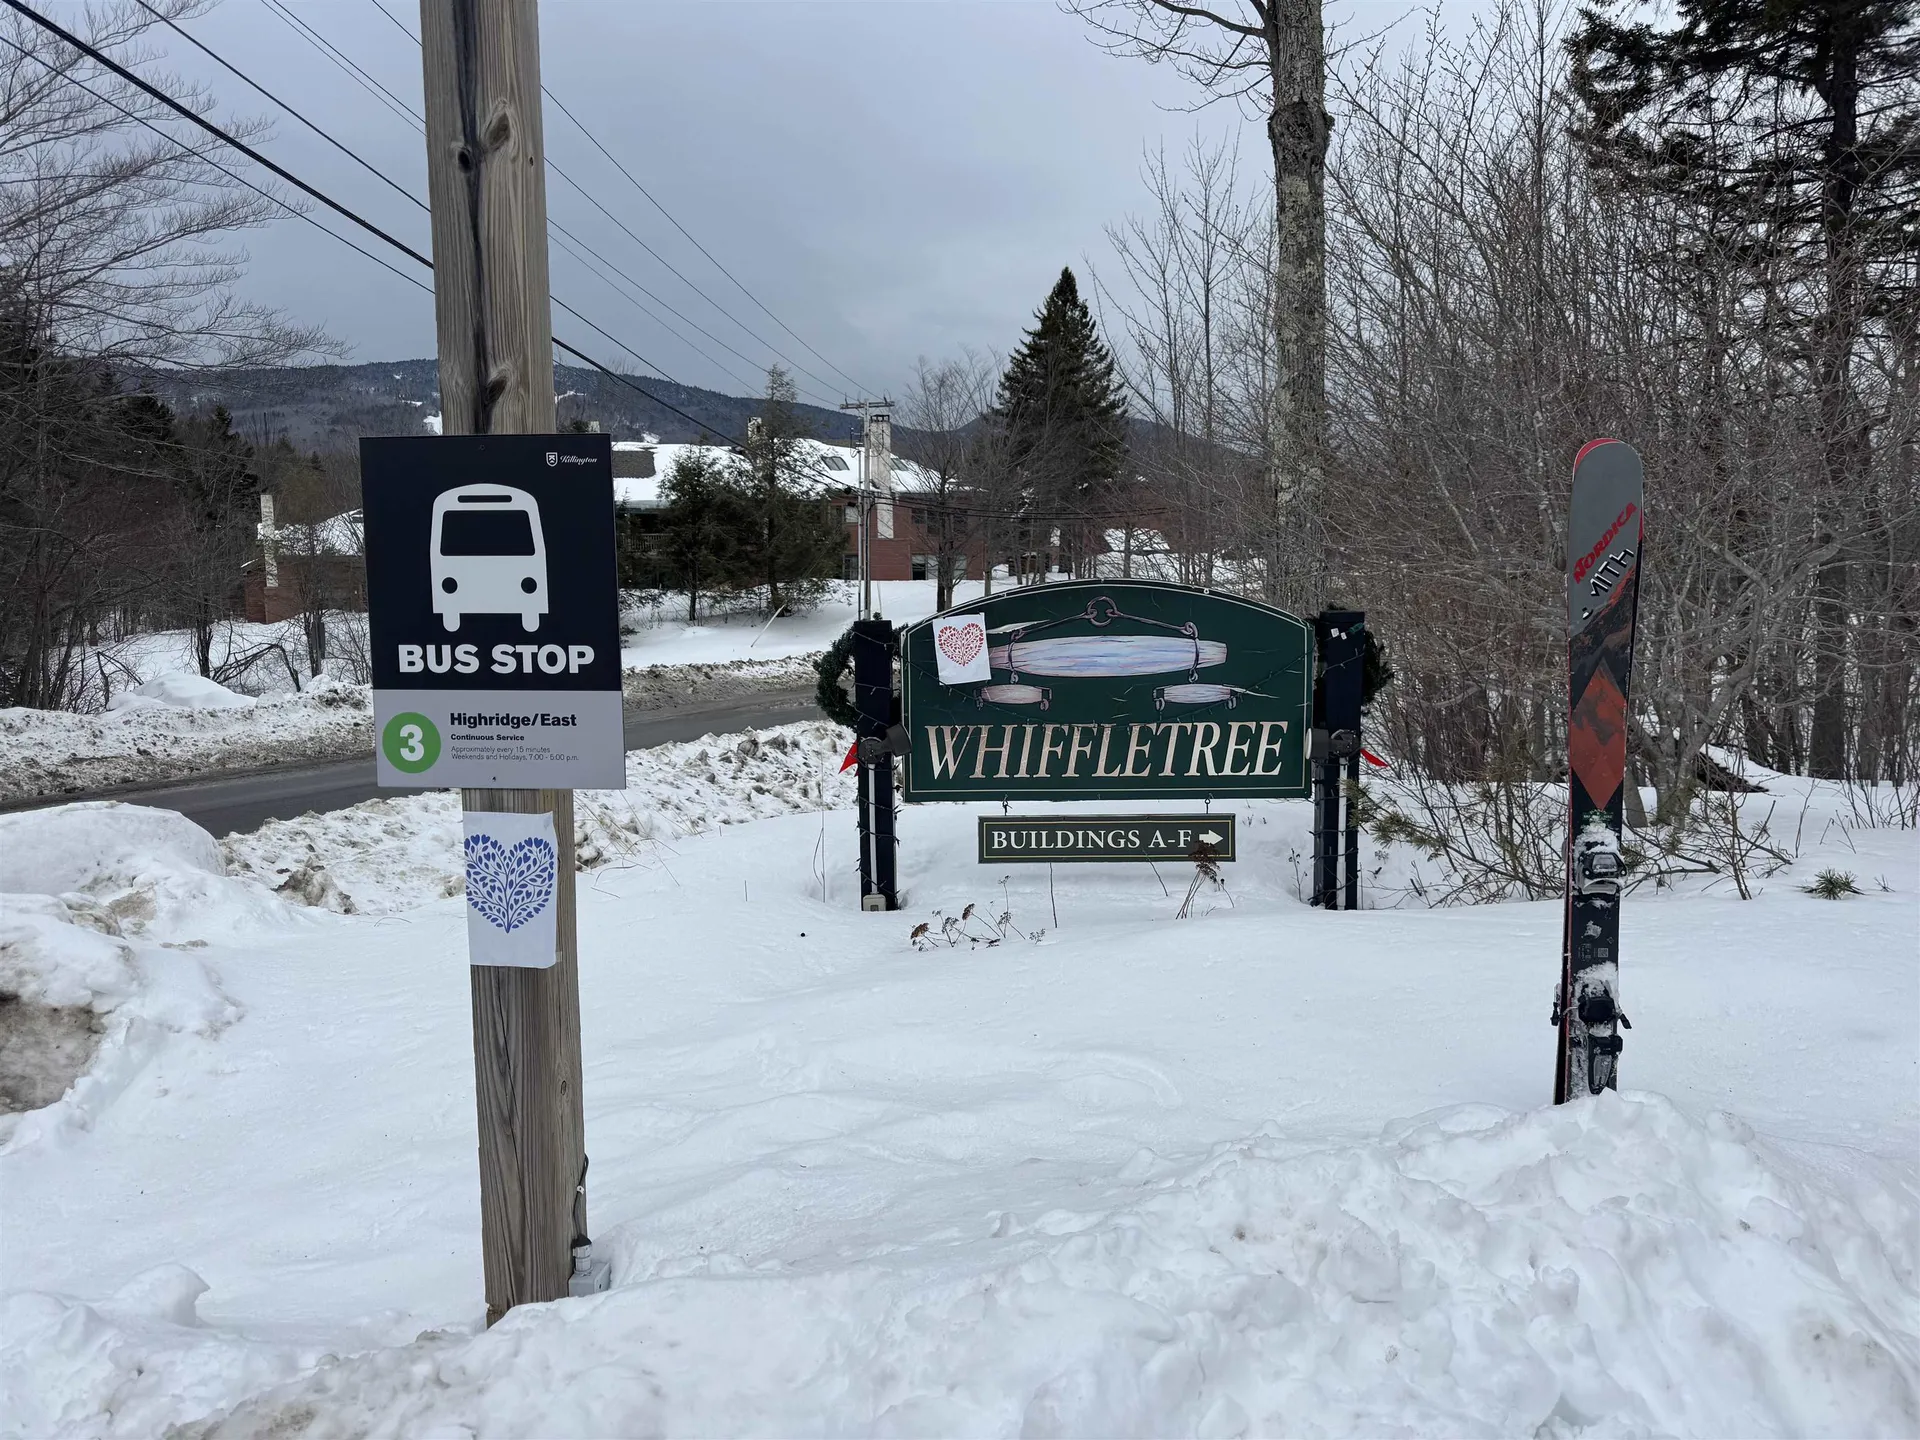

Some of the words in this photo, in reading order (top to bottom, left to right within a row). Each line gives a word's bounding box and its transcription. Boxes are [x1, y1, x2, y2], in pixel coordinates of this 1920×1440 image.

[560, 455, 597, 465] Killington
[398, 644, 480, 674] BUS
[490, 644, 595, 674] STOP
[450, 712, 577, 729] Highridge/East
[400, 724, 425, 762] 3
[450, 733, 494, 741] Continuous
[924, 720, 1288, 780] WHIFFLETREE
[991, 829, 1141, 850] BUILDINGS
[1148, 830, 1192, 848] A-F
